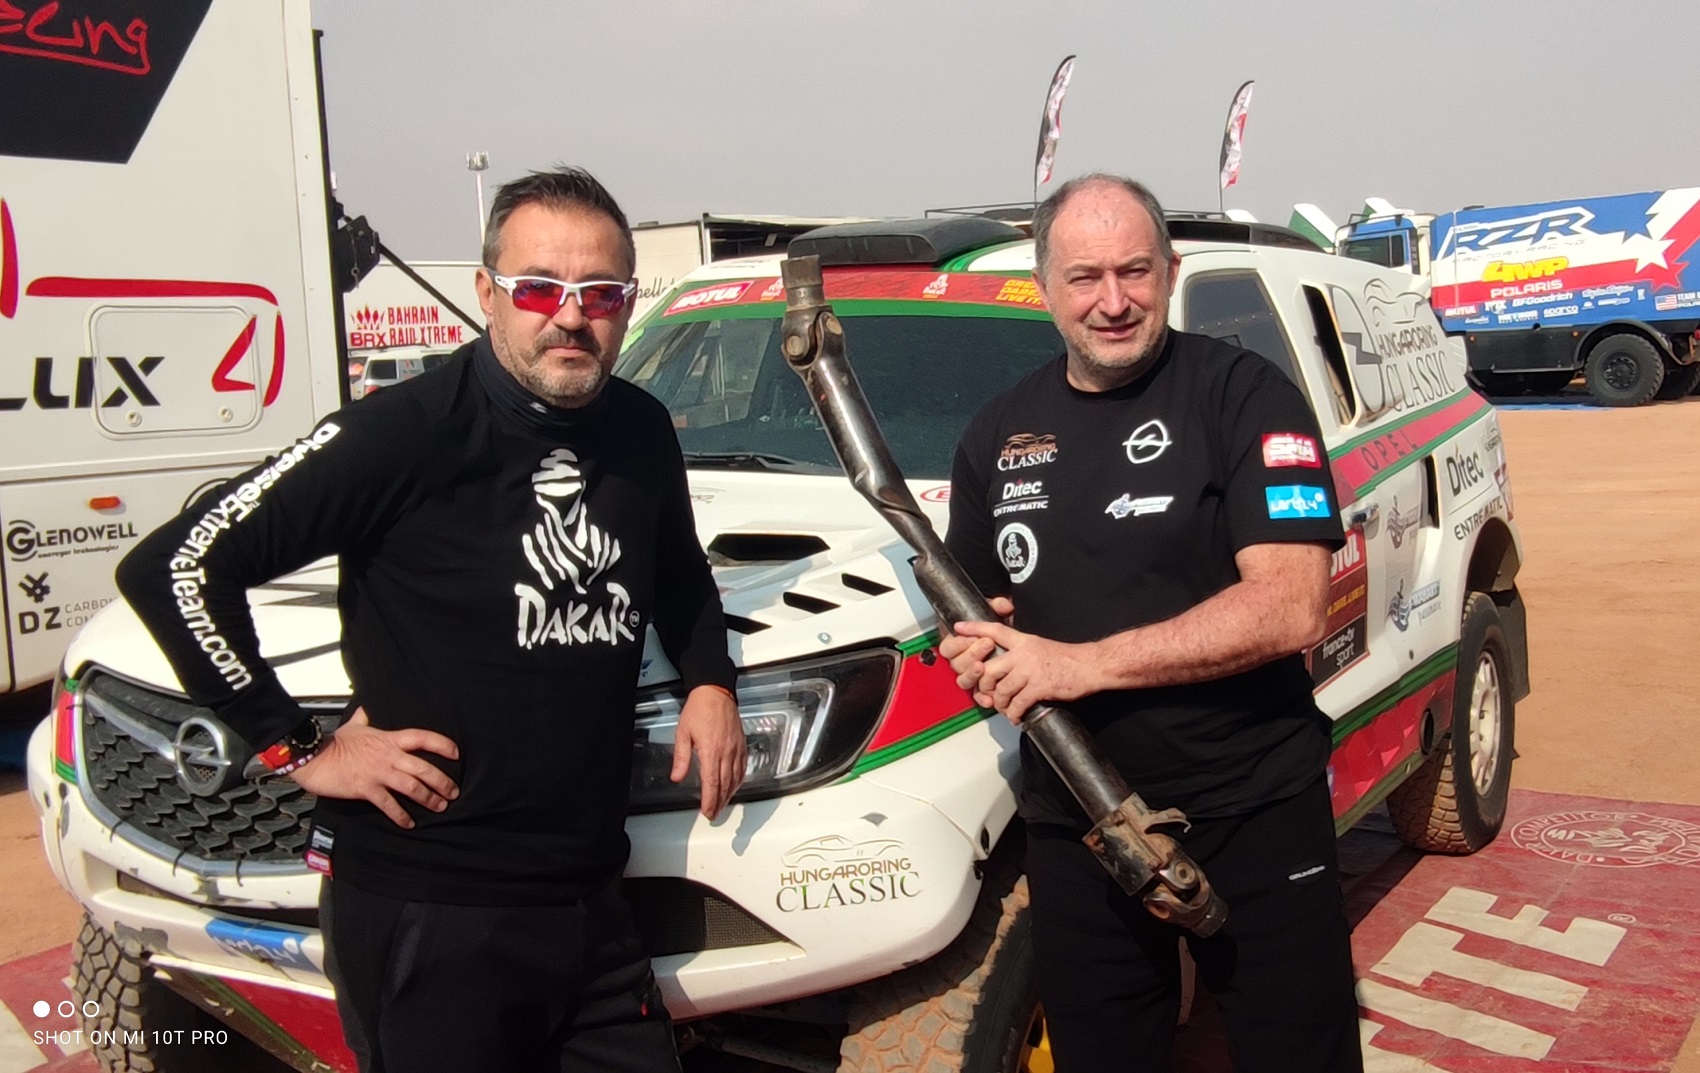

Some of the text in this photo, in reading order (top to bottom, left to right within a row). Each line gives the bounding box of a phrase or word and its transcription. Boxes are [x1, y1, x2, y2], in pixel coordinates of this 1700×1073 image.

[1442, 212, 1586, 260] RZR
[672, 284, 742, 311] MOTUL
[1490, 279, 1563, 299] POLARIS
[387, 305, 439, 326] BAHRAIN
[350, 331, 387, 348] BRX
[389, 325, 464, 346] RAID XTREME
[1375, 324, 1438, 360] HUNGARORING
[1385, 350, 1456, 412] CLASSIC
[997, 448, 1059, 472] CLASSIC
[1361, 429, 1418, 471] OPEL
[1446, 443, 1484, 497] Ditec
[1002, 477, 1043, 501] Ditec
[1453, 495, 1504, 541] ENTREMATIC
[6, 522, 139, 556] GLENOWELL
[18, 606, 62, 635] DZ
[514, 582, 635, 650] DAKAR
[780, 857, 912, 886] HUNGARORING
[775, 871, 923, 913] CLASSIC
